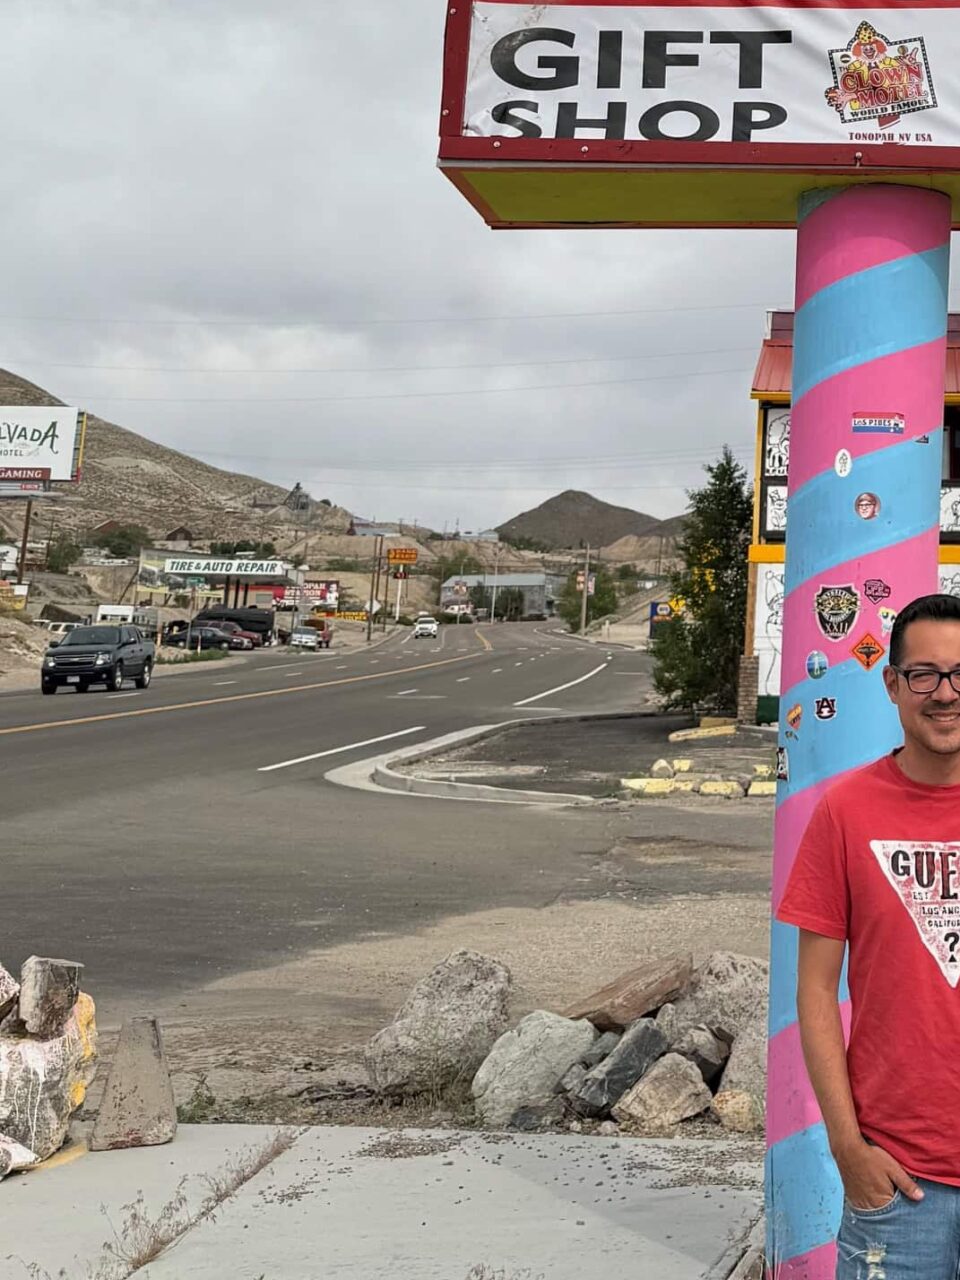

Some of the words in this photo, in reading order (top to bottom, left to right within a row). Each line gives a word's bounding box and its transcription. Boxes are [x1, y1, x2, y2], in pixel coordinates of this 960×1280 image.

[490, 27, 793, 91] GIFT
[841, 62, 923, 93] CLOWN
[857, 83, 929, 110] MOTEL
[850, 106, 888, 118] WORLD
[890, 99, 929, 112] FAMOUS
[489, 99, 788, 142] SHOP
[848, 132, 894, 141] TONOPAH
[899, 133, 911, 141] NV
[916, 133, 933, 142] USA
[170, 561, 193, 571] TIRE
[195, 562, 201, 570] &
[202, 561, 233, 572] AUTO
[236, 562, 278, 573] REPAIR
[922, 906, 939, 915] LOS
